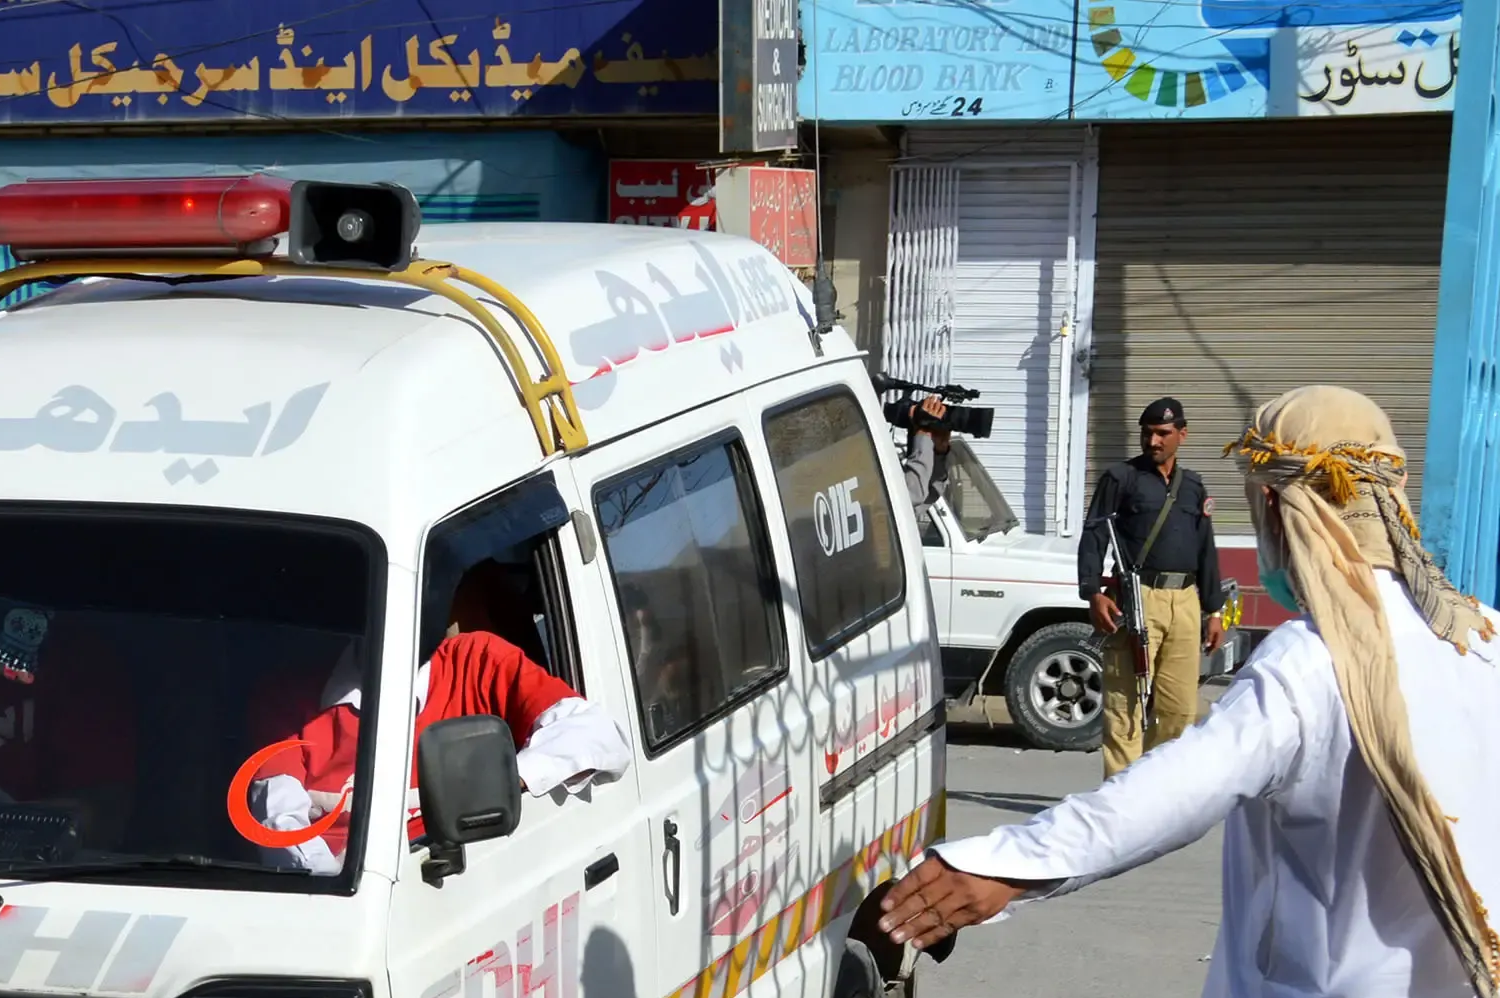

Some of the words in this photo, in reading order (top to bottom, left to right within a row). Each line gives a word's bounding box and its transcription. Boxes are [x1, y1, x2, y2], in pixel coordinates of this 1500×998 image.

[269, 22, 372, 104] اینڈ
[382, 17, 587, 102] میڈیکل
[822, 25, 1009, 53] LABORATORY
[1016, 23, 1070, 51] AND
[48, 40, 260, 109] سرجیکل
[831, 64, 925, 93] BLOOD
[932, 62, 1030, 92] BANK
[951, 96, 983, 117] 24
